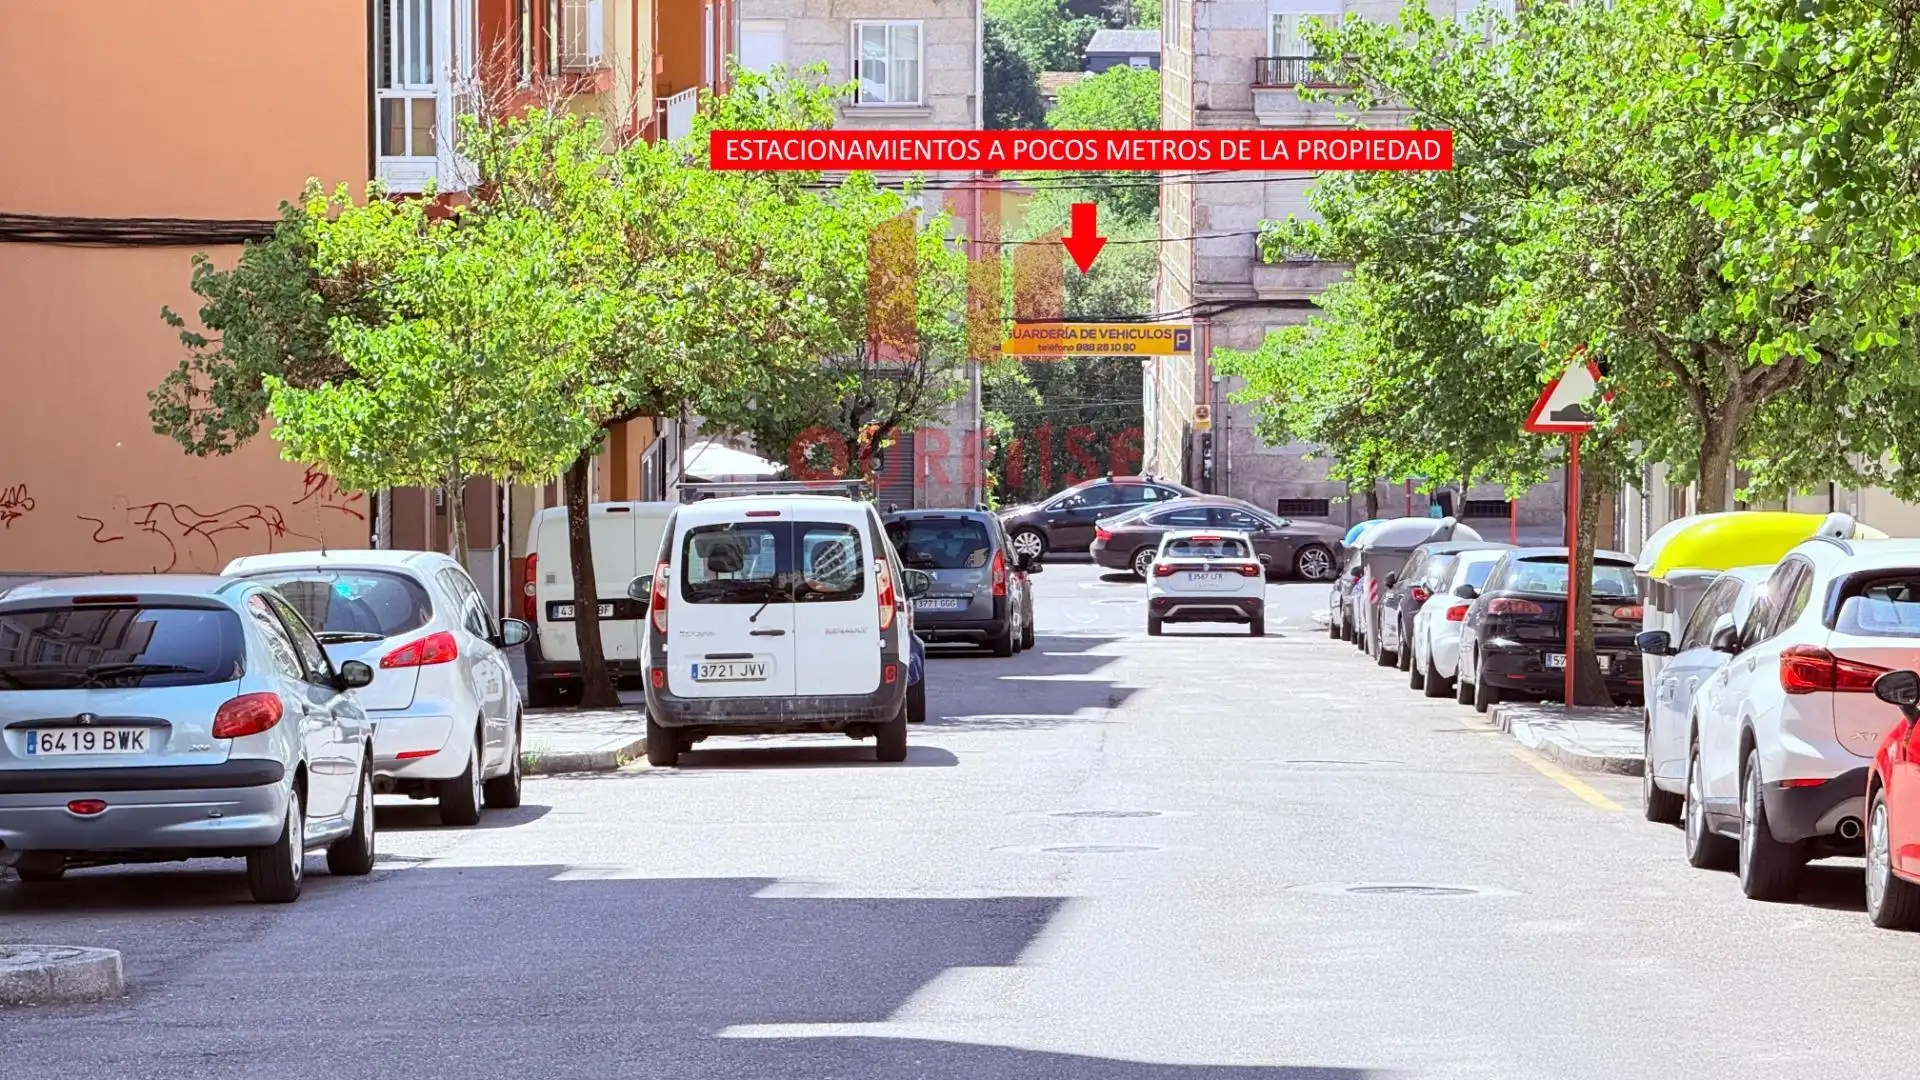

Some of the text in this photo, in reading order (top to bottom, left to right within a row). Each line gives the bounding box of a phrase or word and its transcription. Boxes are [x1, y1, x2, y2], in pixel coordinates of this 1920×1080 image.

[1080, 328, 1097, 340] DE
[1099, 328, 1172, 340] VEHICULOS
[1176, 333, 1188, 348] P
[701, 663, 765, 678] 3721 JVV
[41, 730, 145, 752] 6419 BWK
